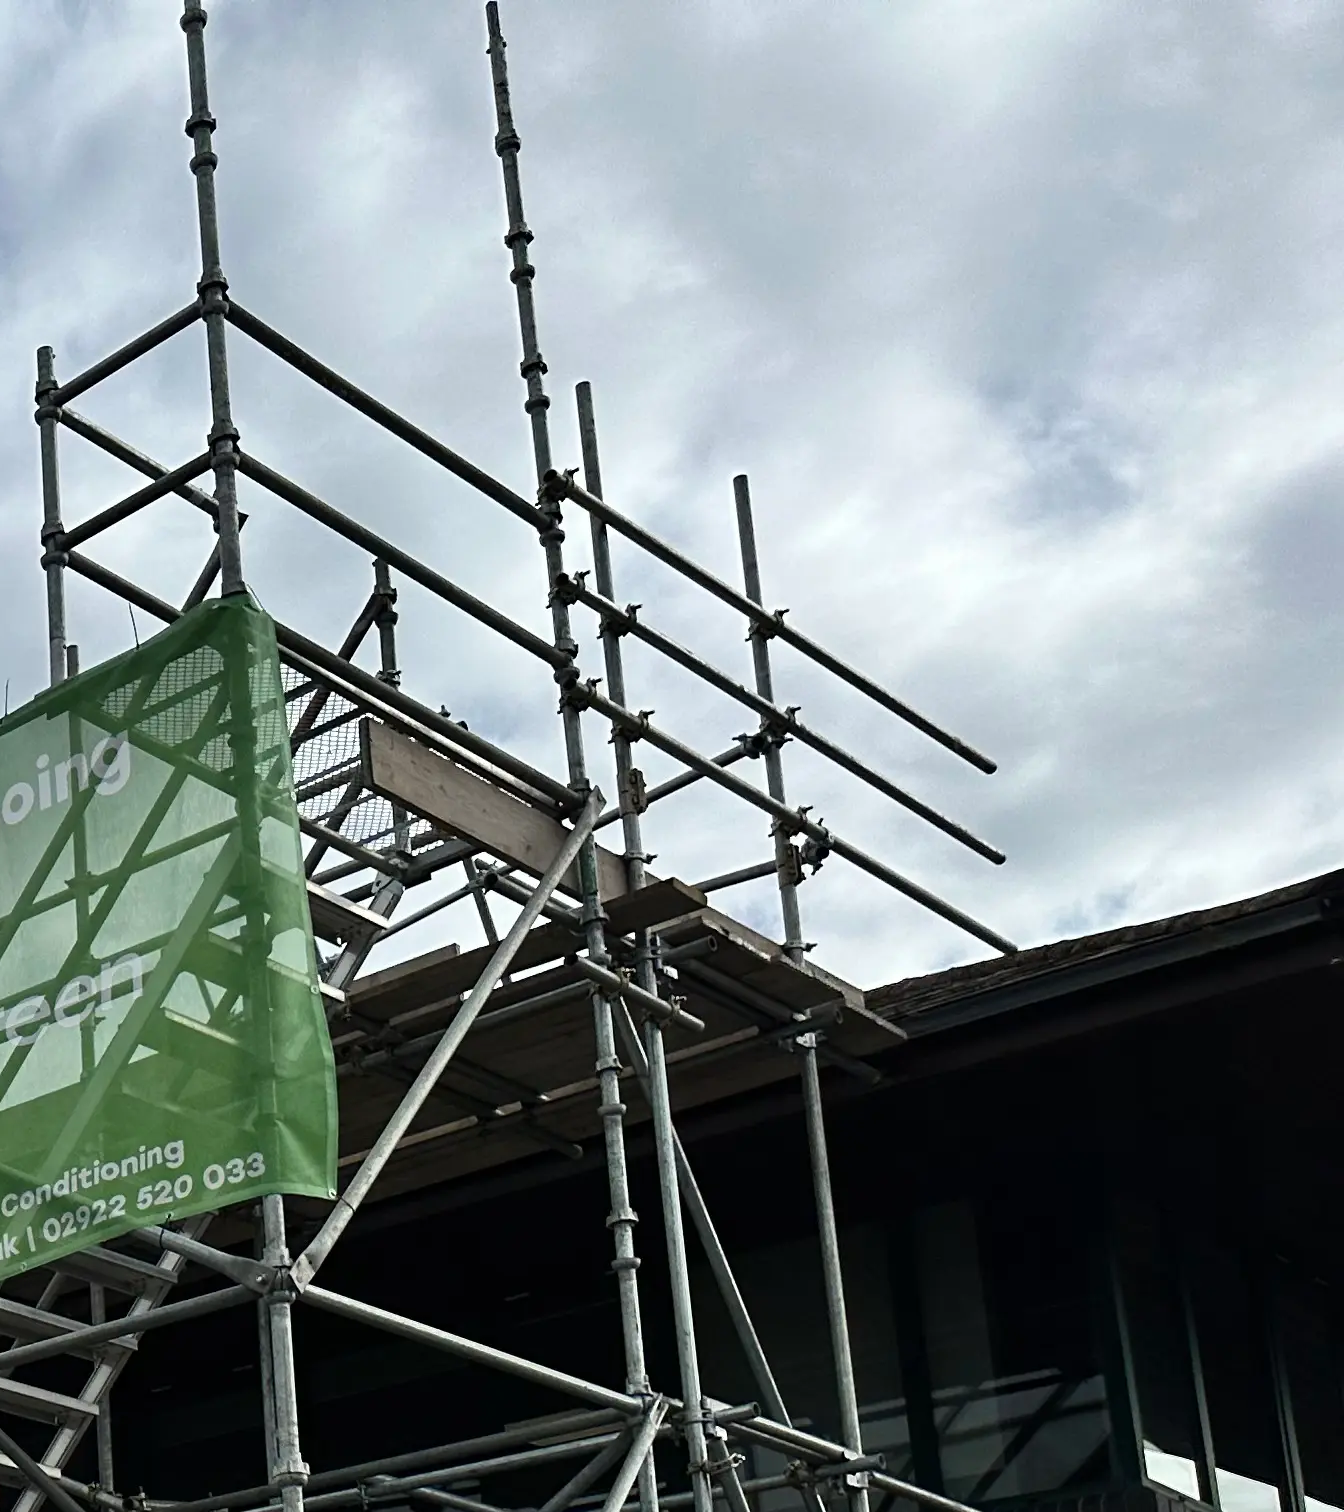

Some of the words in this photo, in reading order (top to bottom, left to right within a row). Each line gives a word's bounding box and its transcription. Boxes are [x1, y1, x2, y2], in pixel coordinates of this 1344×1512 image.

[1, 1139, 184, 1217] Conditioning
[43, 1194, 126, 1242] 02922
[136, 1175, 192, 1210] 520
[203, 1152, 266, 1190] 033
